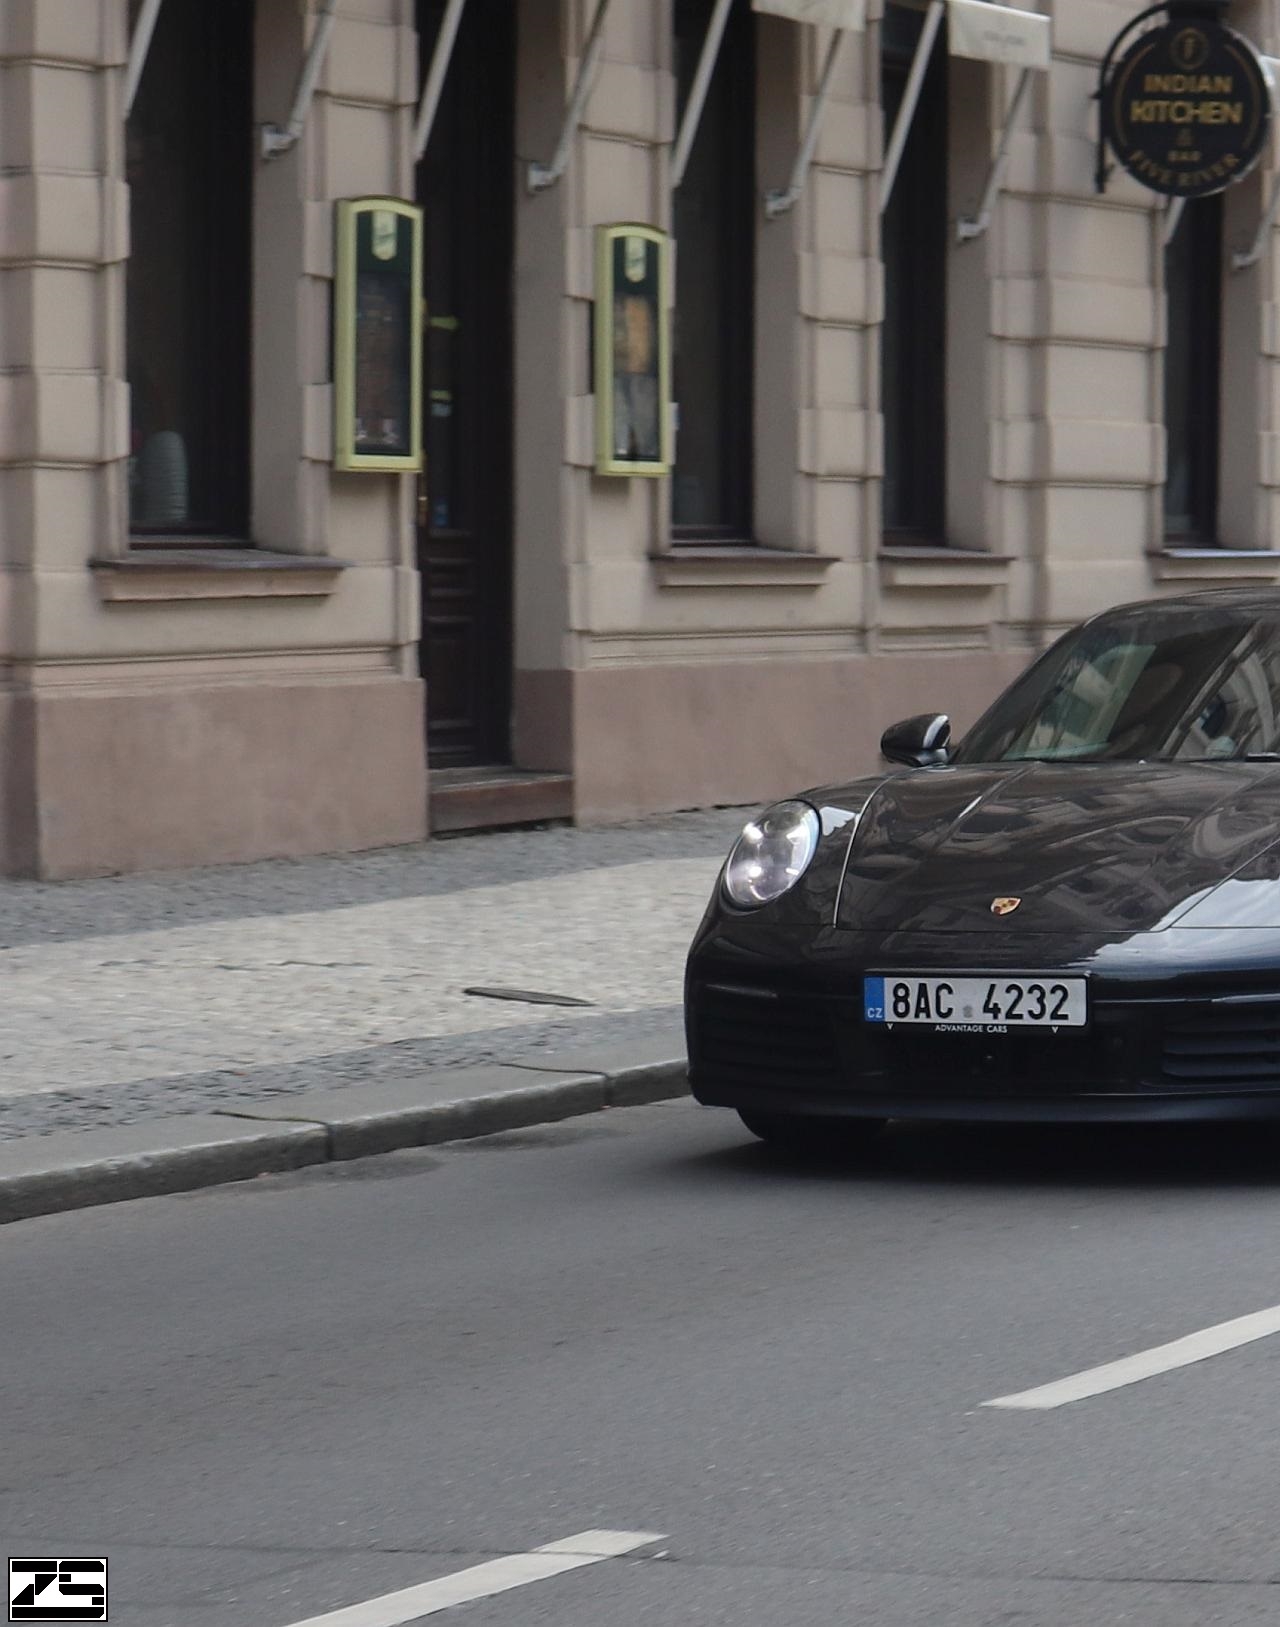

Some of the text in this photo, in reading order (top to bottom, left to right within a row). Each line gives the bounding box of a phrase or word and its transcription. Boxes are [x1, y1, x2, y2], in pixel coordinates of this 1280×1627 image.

[1143, 74, 1233, 93] INDIAN
[1130, 101, 1243, 124] KITCHEN
[892, 982, 1069, 1021] 8AC 4232
[867, 1007, 883, 1019] CZ
[935, 1024, 1008, 1034] ADVANTAGE CARS
